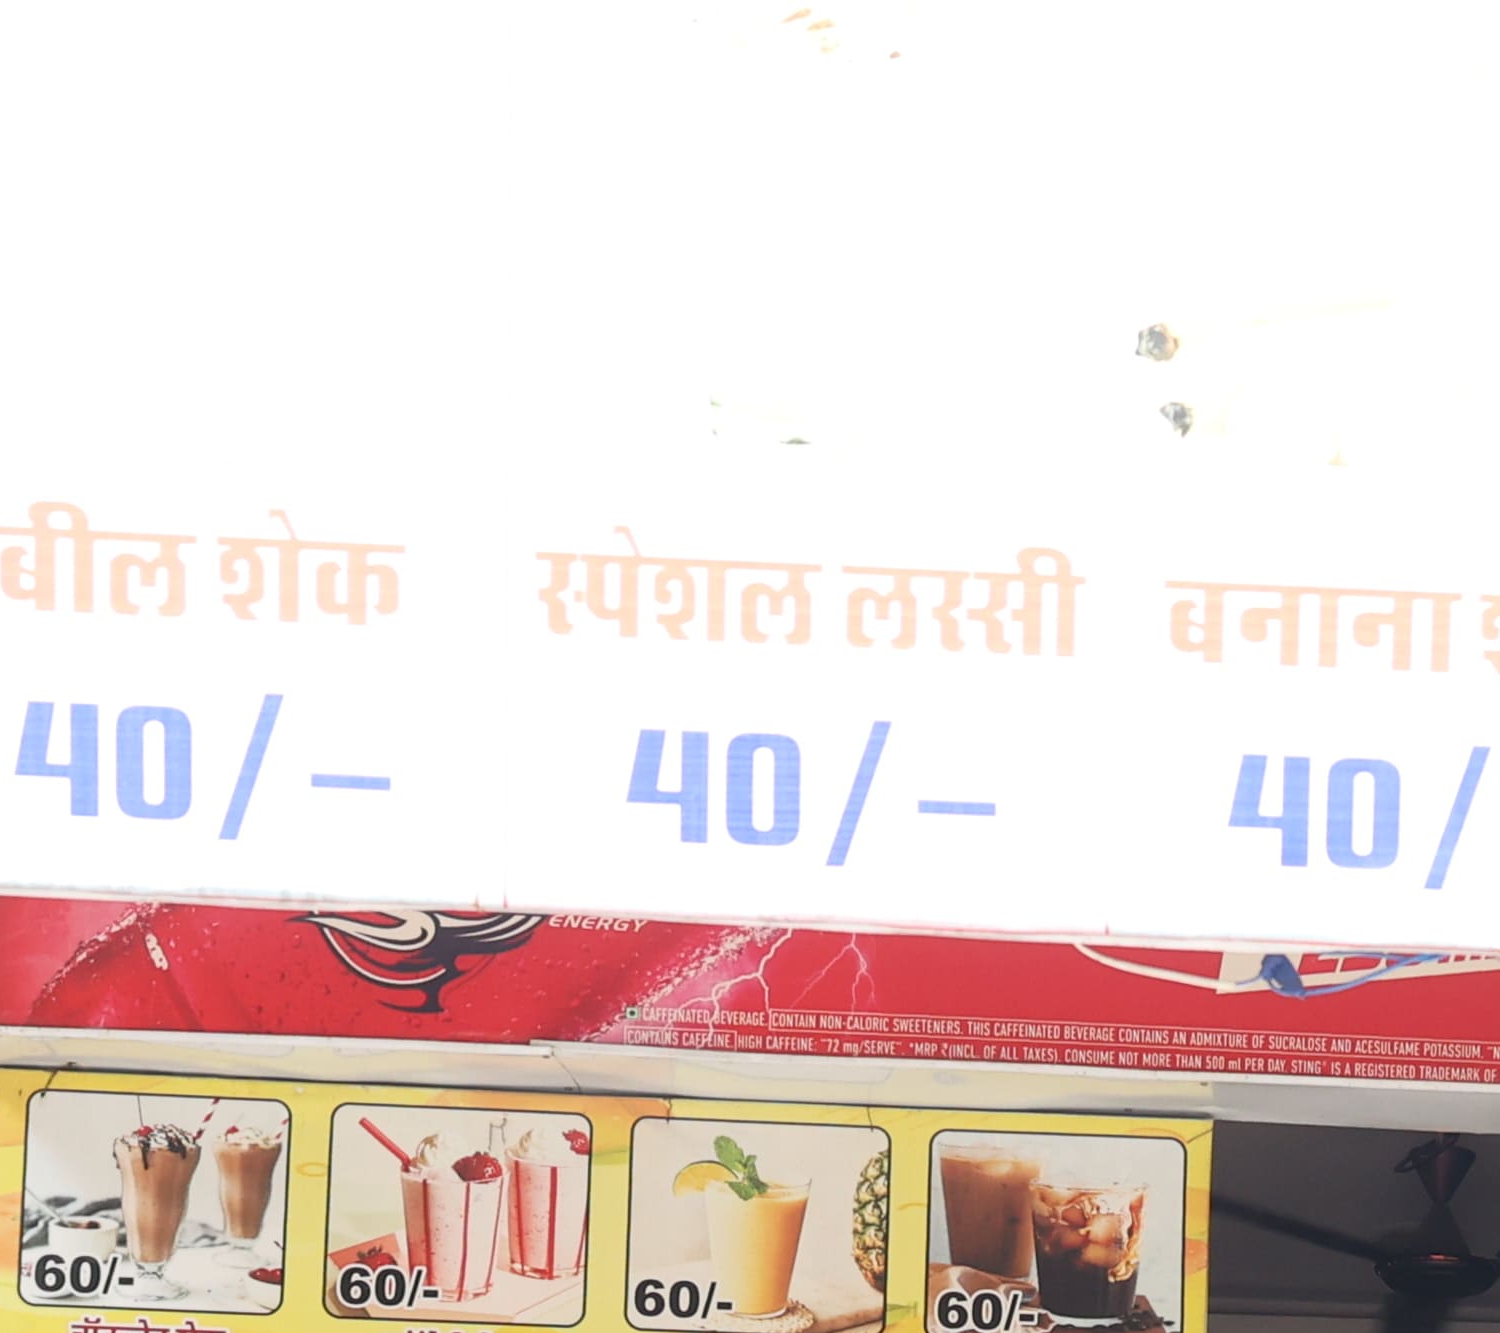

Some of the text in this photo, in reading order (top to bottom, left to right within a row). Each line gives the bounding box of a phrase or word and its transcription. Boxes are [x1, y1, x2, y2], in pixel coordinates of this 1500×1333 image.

[218, 509, 406, 626] शेक
[536, 525, 1085, 657] स्पेशल लस्सी
[1164, 579, 1462, 673] बनाना
[34, 1252, 135, 1297] 60/-
[338, 1265, 441, 1309] 60/-
[633, 1278, 734, 1320] 60/-
[936, 1290, 1039, 1332] 60/-
